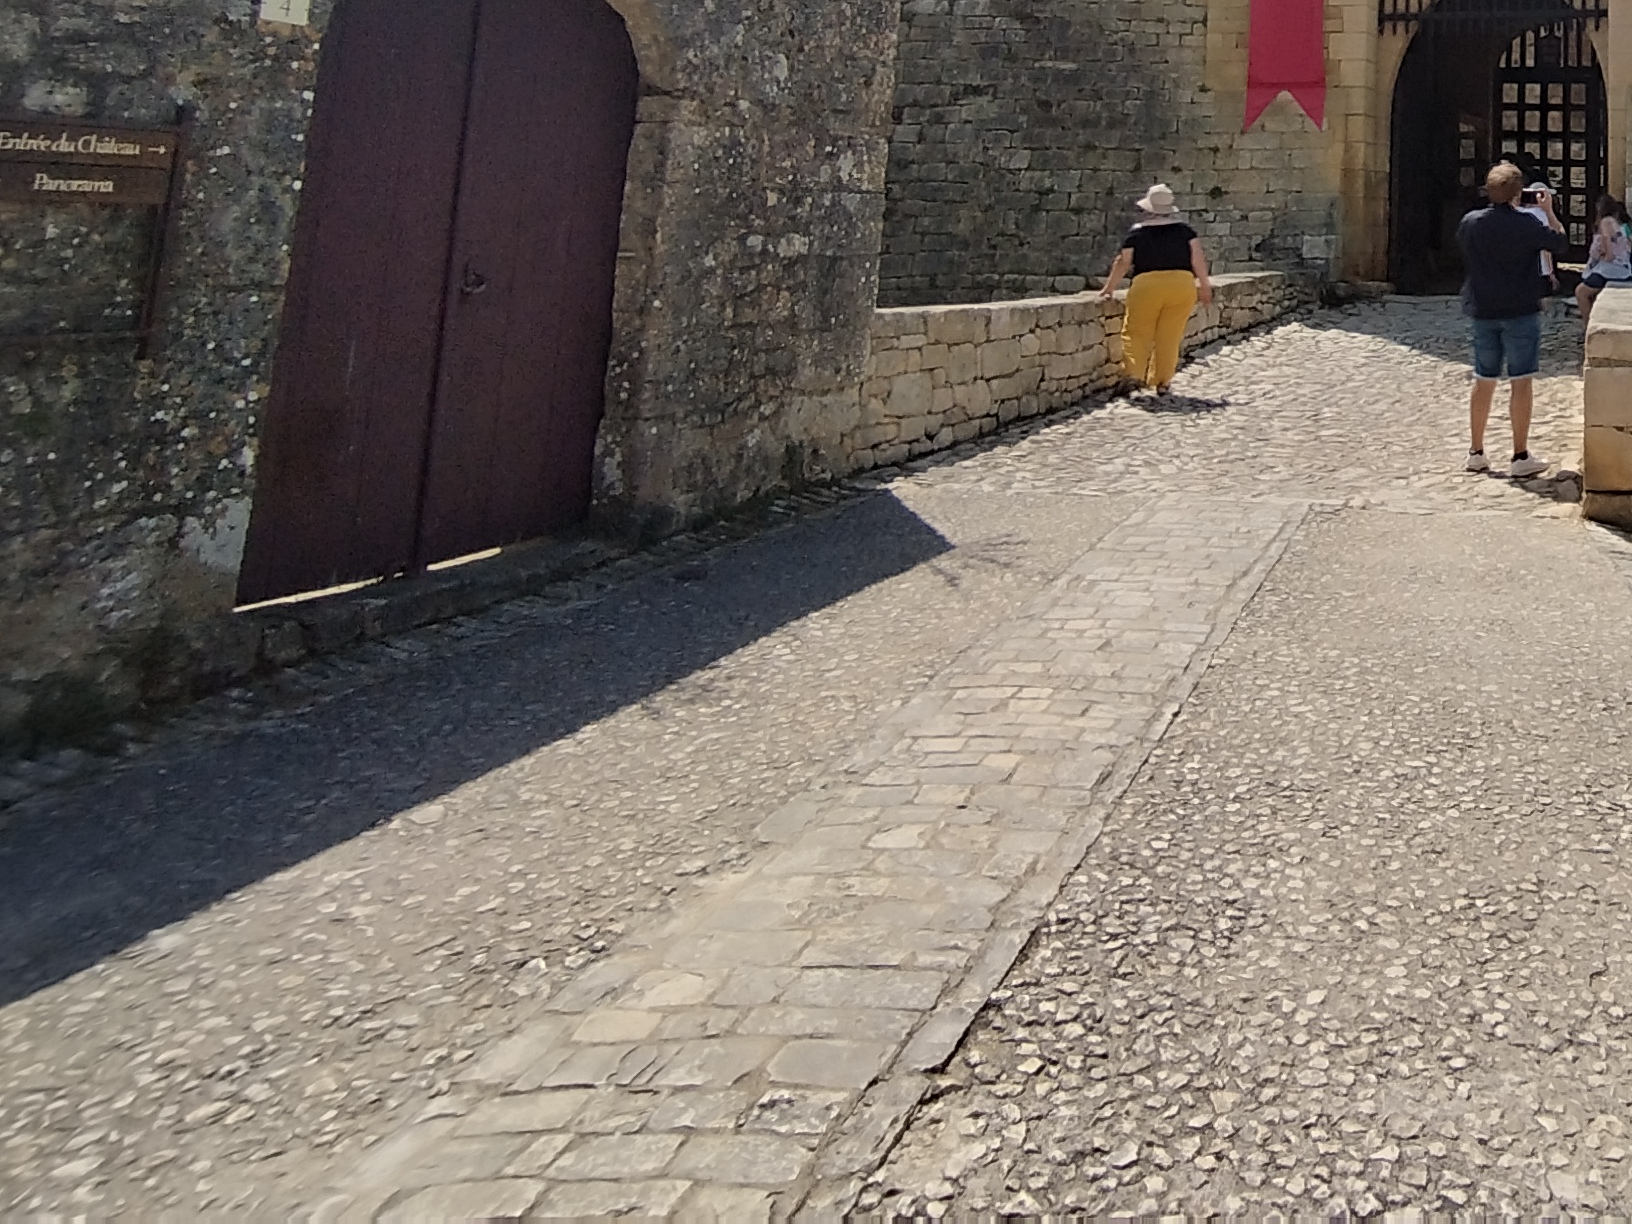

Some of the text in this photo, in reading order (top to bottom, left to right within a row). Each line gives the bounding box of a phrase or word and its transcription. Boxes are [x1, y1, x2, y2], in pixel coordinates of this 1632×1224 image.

[0, 130, 141, 156] Entrée du Château
[33, 172, 115, 193] Panorama
